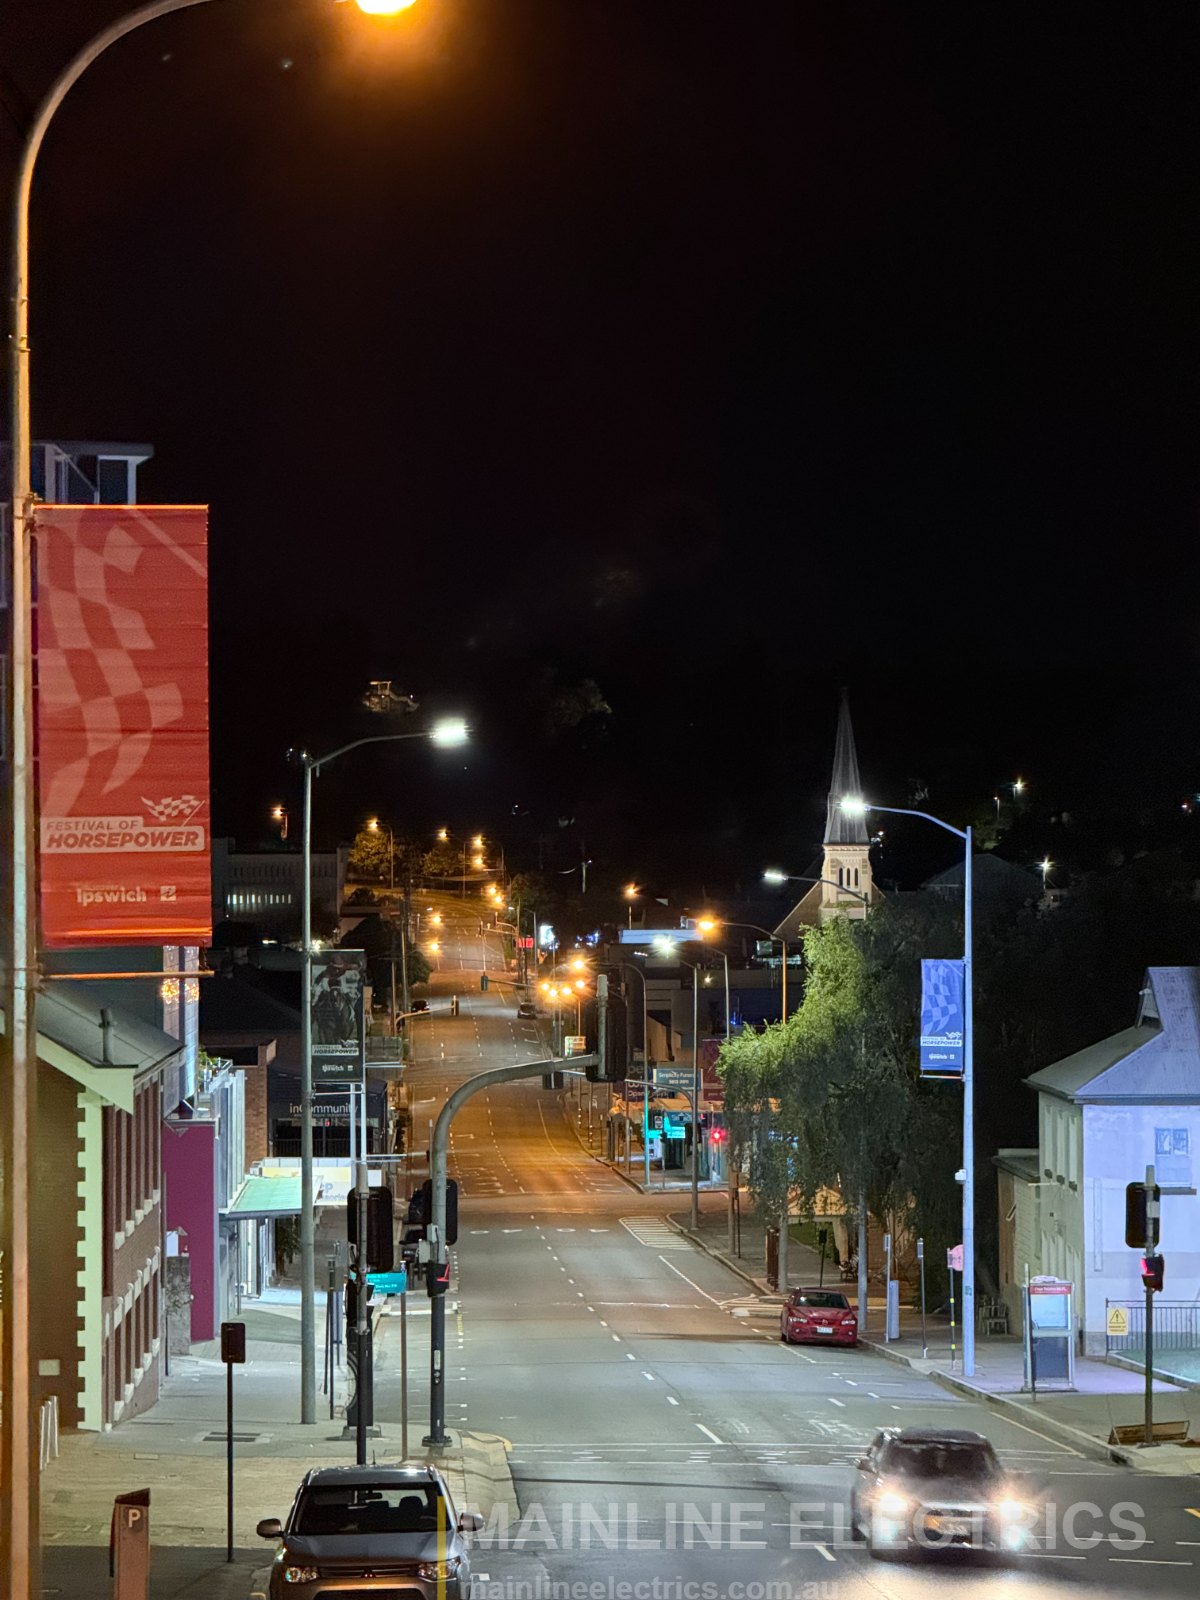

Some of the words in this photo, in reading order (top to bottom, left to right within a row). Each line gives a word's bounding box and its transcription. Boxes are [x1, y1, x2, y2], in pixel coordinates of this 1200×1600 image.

[46, 819, 113, 831] FESTIVAL
[118, 819, 139, 831] OF
[46, 831, 199, 849] HORSEPOWER
[76, 886, 147, 907] Ipswich
[290, 1103, 358, 1114] inmmuni
[129, 1509, 141, 1528] P
